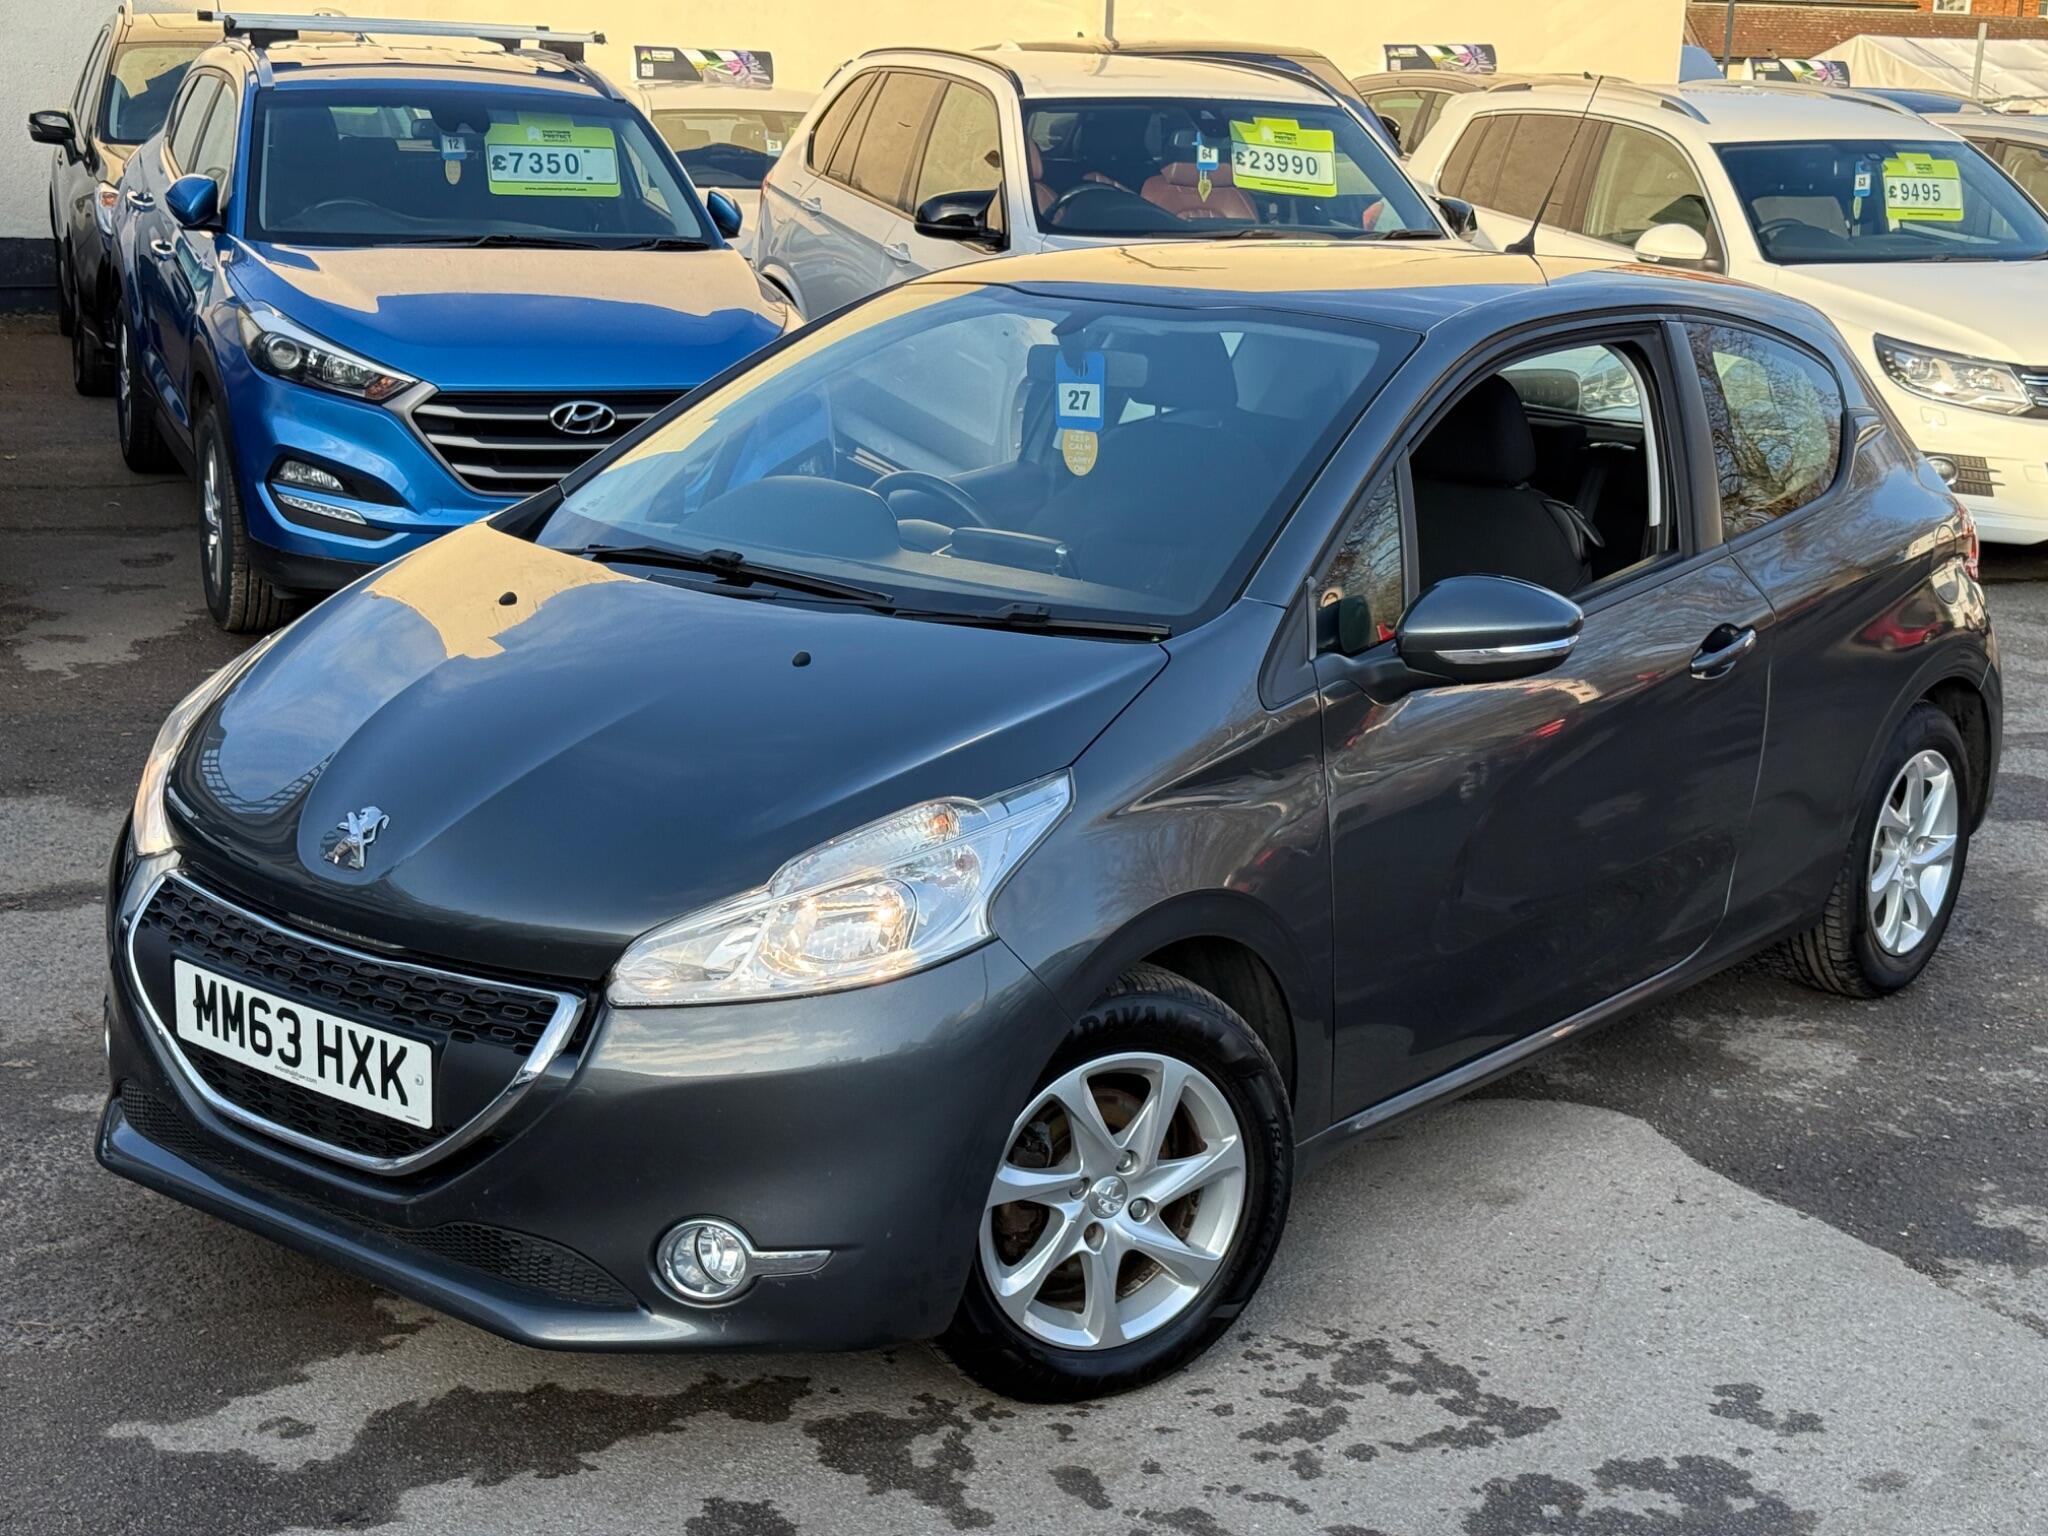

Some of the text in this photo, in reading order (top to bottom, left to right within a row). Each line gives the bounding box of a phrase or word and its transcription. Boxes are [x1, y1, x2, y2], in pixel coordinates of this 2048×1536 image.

[448, 138, 460, 150] 12
[1202, 149, 1212, 159] 64
[492, 152, 580, 175] £7350
[1235, 150, 1318, 175] £23990
[1889, 183, 1941, 202] £9495
[1068, 390, 1091, 411] 27
[194, 974, 409, 1107] MM63 HXK
